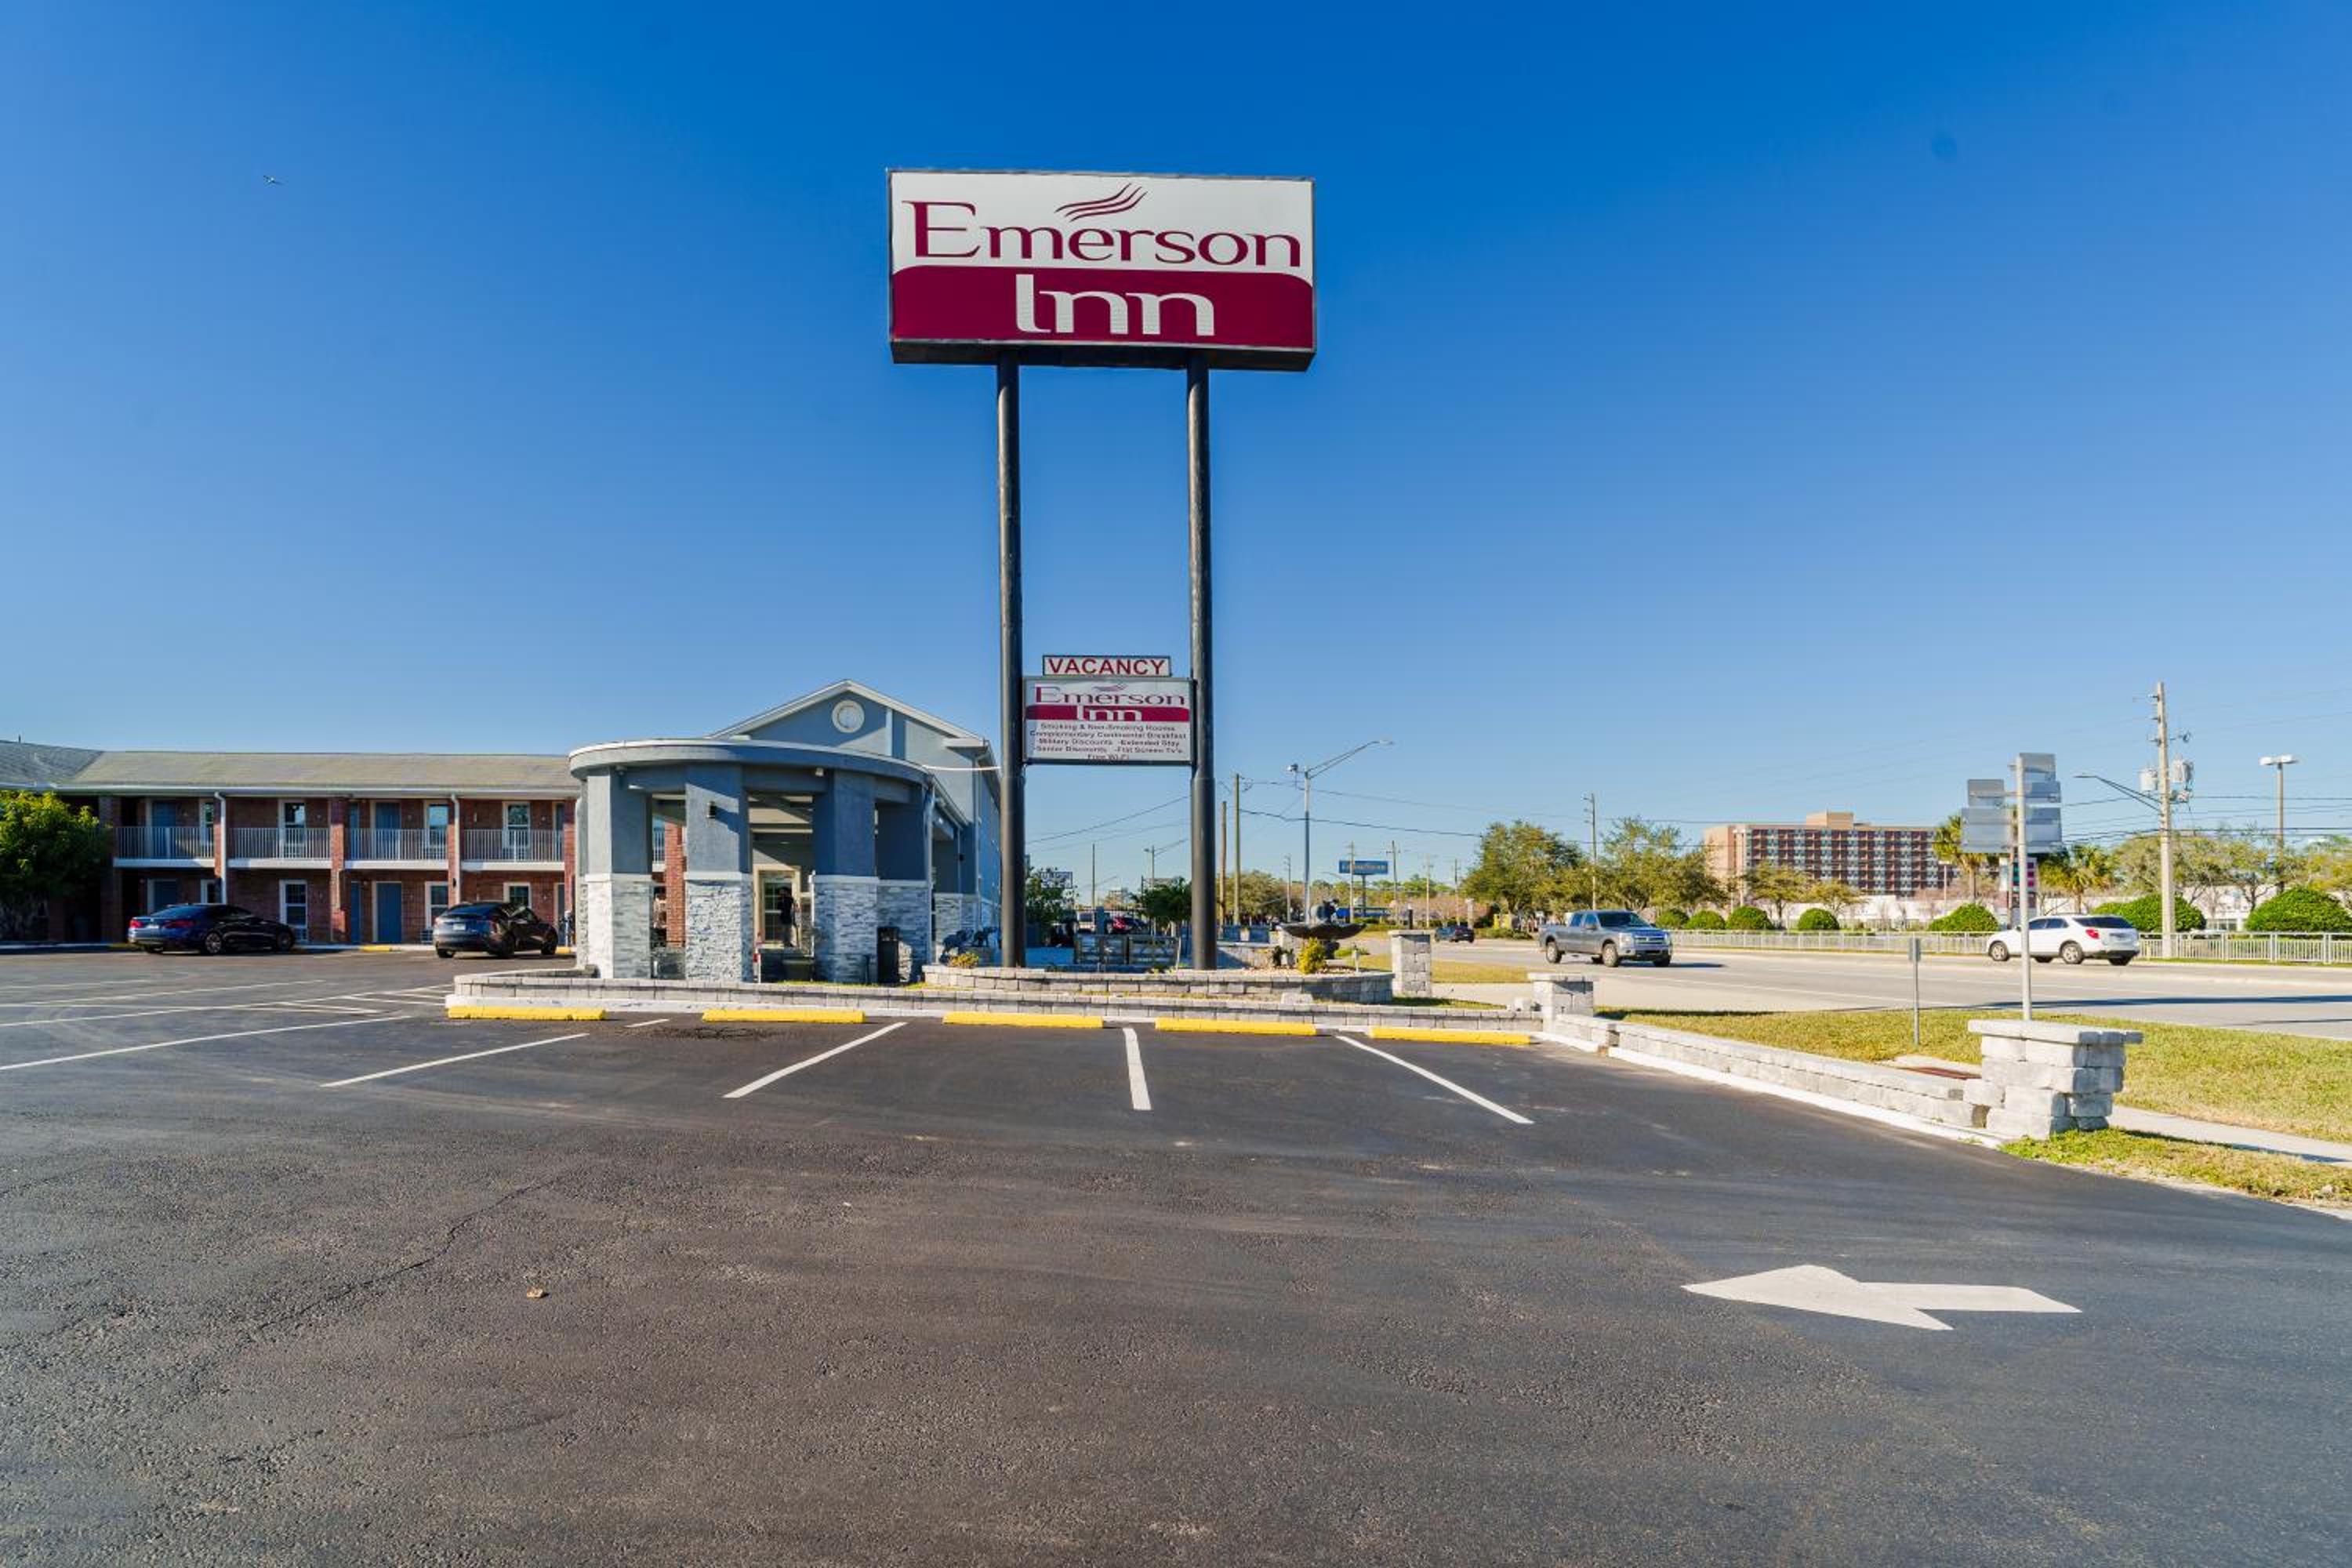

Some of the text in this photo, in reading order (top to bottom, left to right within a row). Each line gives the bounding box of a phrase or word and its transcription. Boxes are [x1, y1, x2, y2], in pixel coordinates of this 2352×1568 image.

[902, 201, 1301, 267] Emerson
[1015, 274, 1215, 336] Inn
[1048, 659, 1166, 675] VACANCY
[1035, 685, 1185, 706] Emerson
[1076, 706, 1142, 721] Inn
